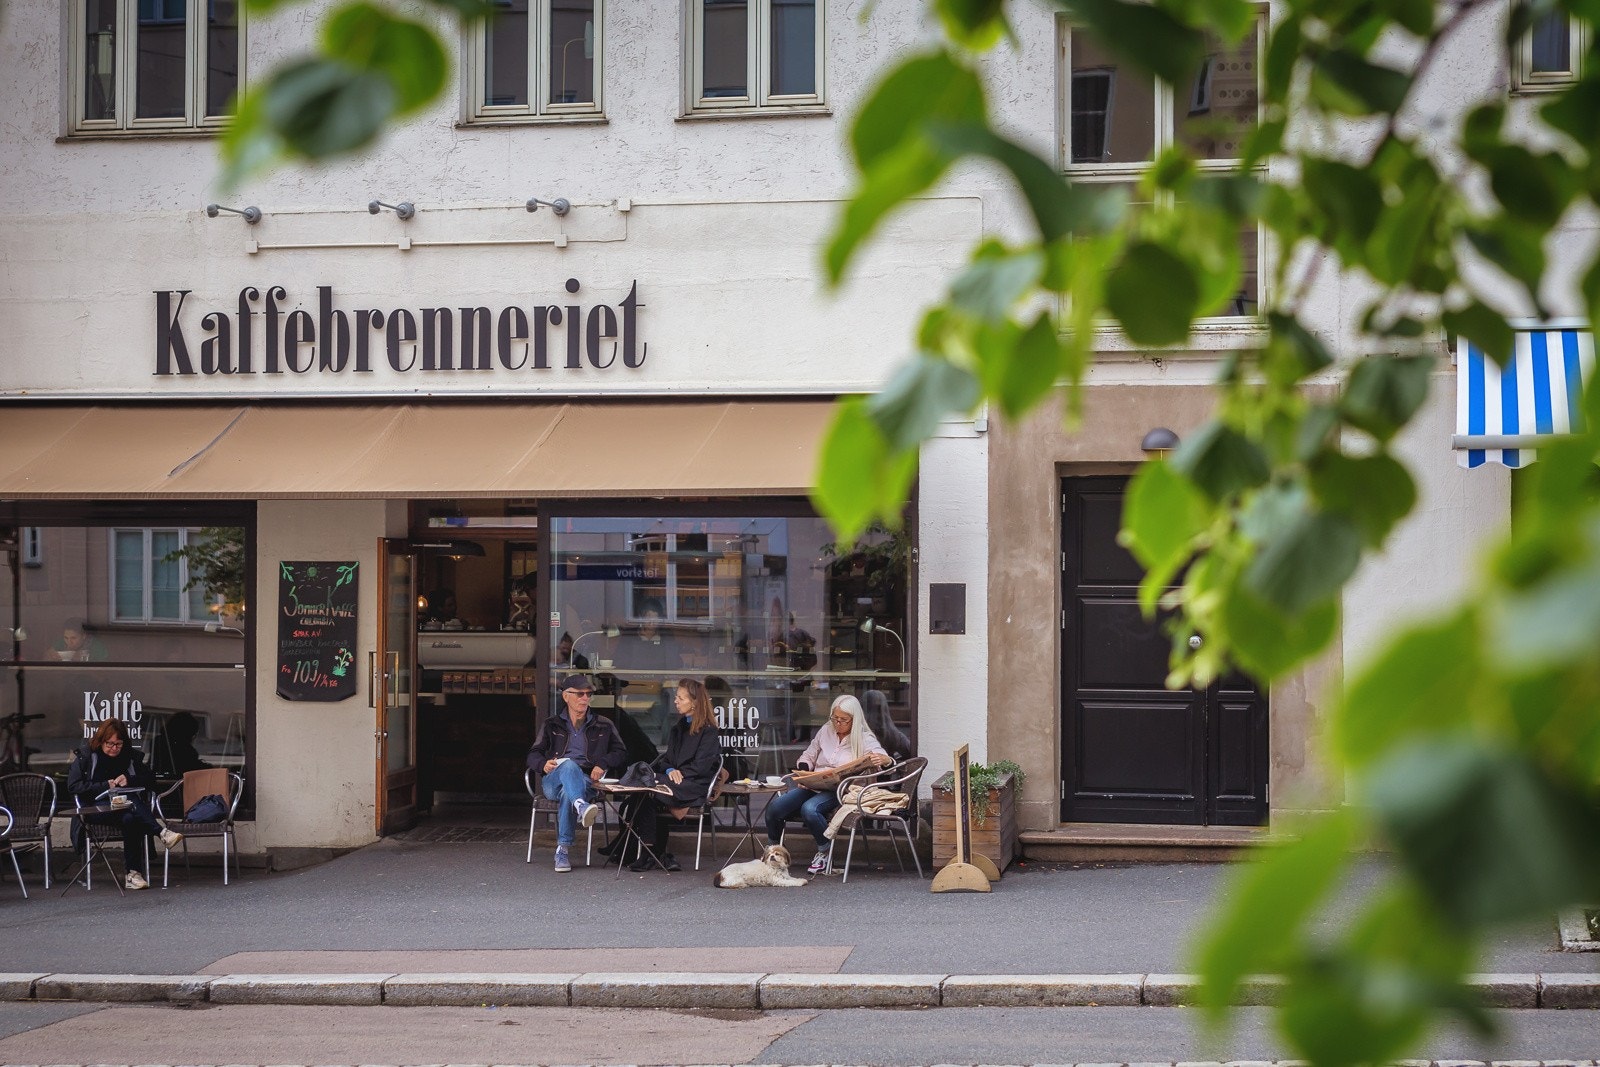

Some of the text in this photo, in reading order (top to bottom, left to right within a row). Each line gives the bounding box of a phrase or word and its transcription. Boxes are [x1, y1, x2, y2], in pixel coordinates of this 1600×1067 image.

[152, 278, 648, 376] Kaffebrenneriet
[84, 692, 142, 722] Kaffe
[711, 698, 760, 730] affe
